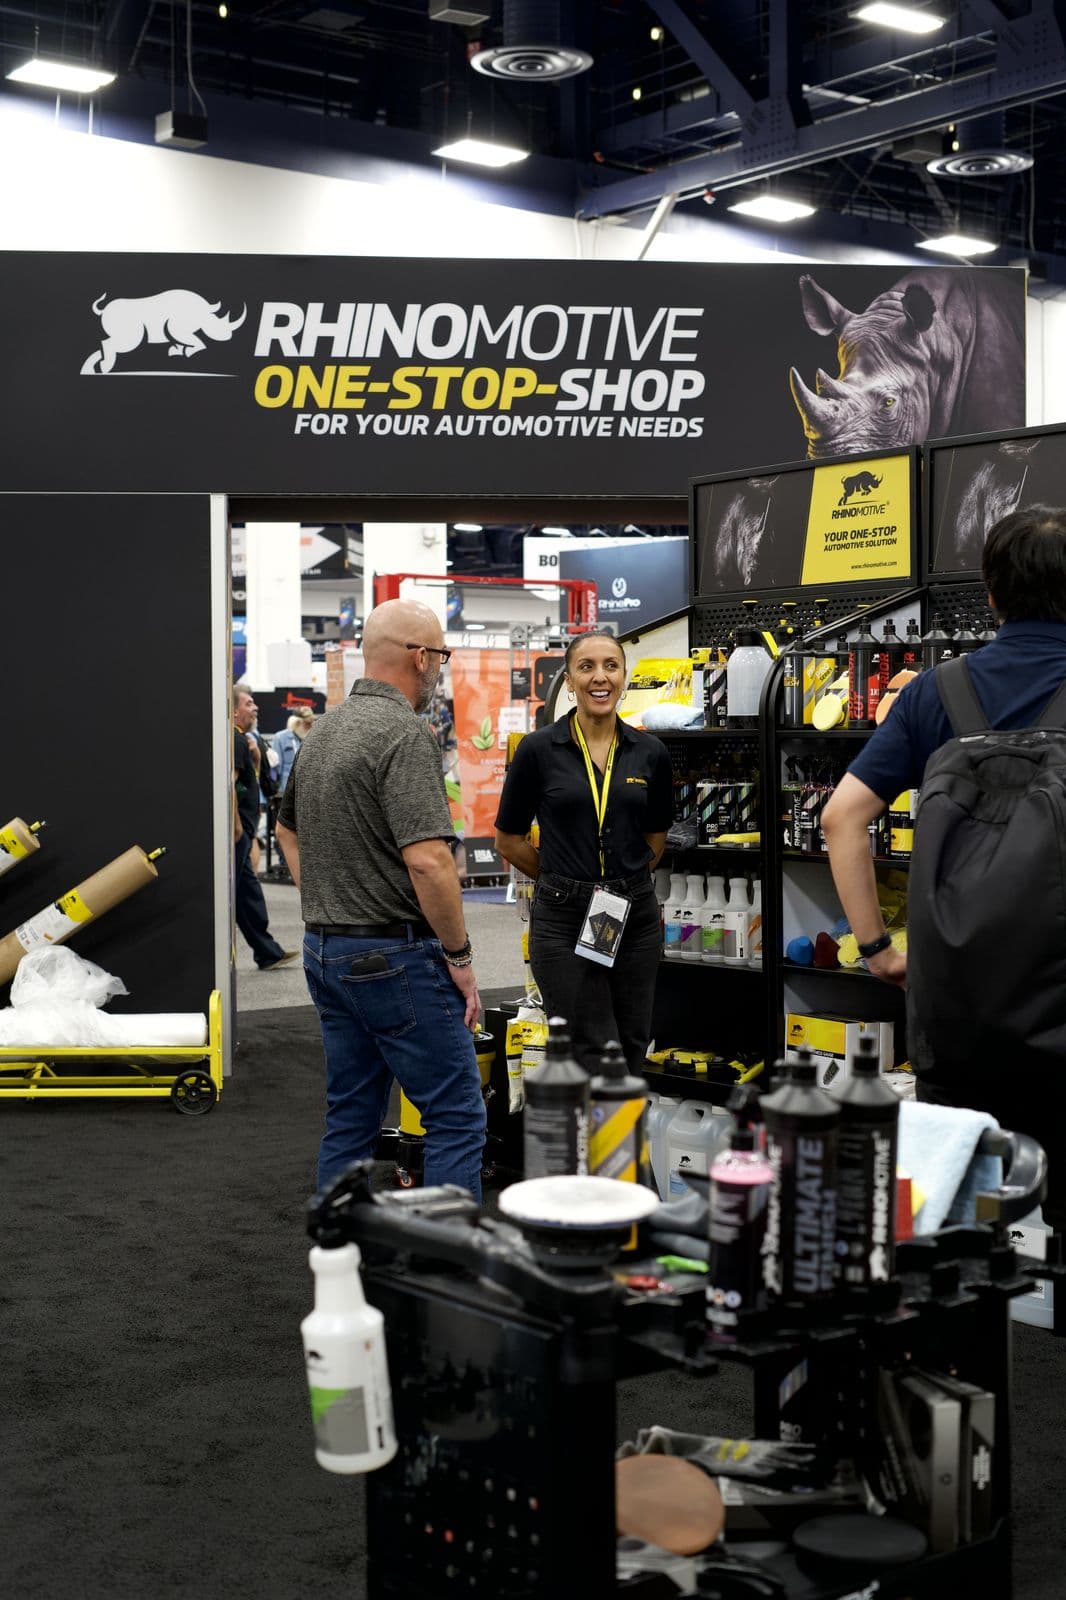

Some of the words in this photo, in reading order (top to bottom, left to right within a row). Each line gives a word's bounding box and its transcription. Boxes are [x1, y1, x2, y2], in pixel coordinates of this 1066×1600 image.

[254, 302, 705, 361] RHINOMOTIVE
[253, 364, 706, 412] ONE-STOP-SHOP
[294, 413, 347, 435] FOR
[355, 413, 430, 436] YOUR
[434, 414, 613, 437] AUTOMOTIVE
[618, 416, 705, 438] NEEDS
[831, 503, 886, 520] RHINOMOTIVE
[823, 540, 864, 552] AUTOMOTIVE
[865, 537, 897, 548] SOLUTION
[824, 530, 848, 543] YOUR
[849, 525, 897, 541] ONE-STOP
[793, 1137, 824, 1293] ULTIMATE
